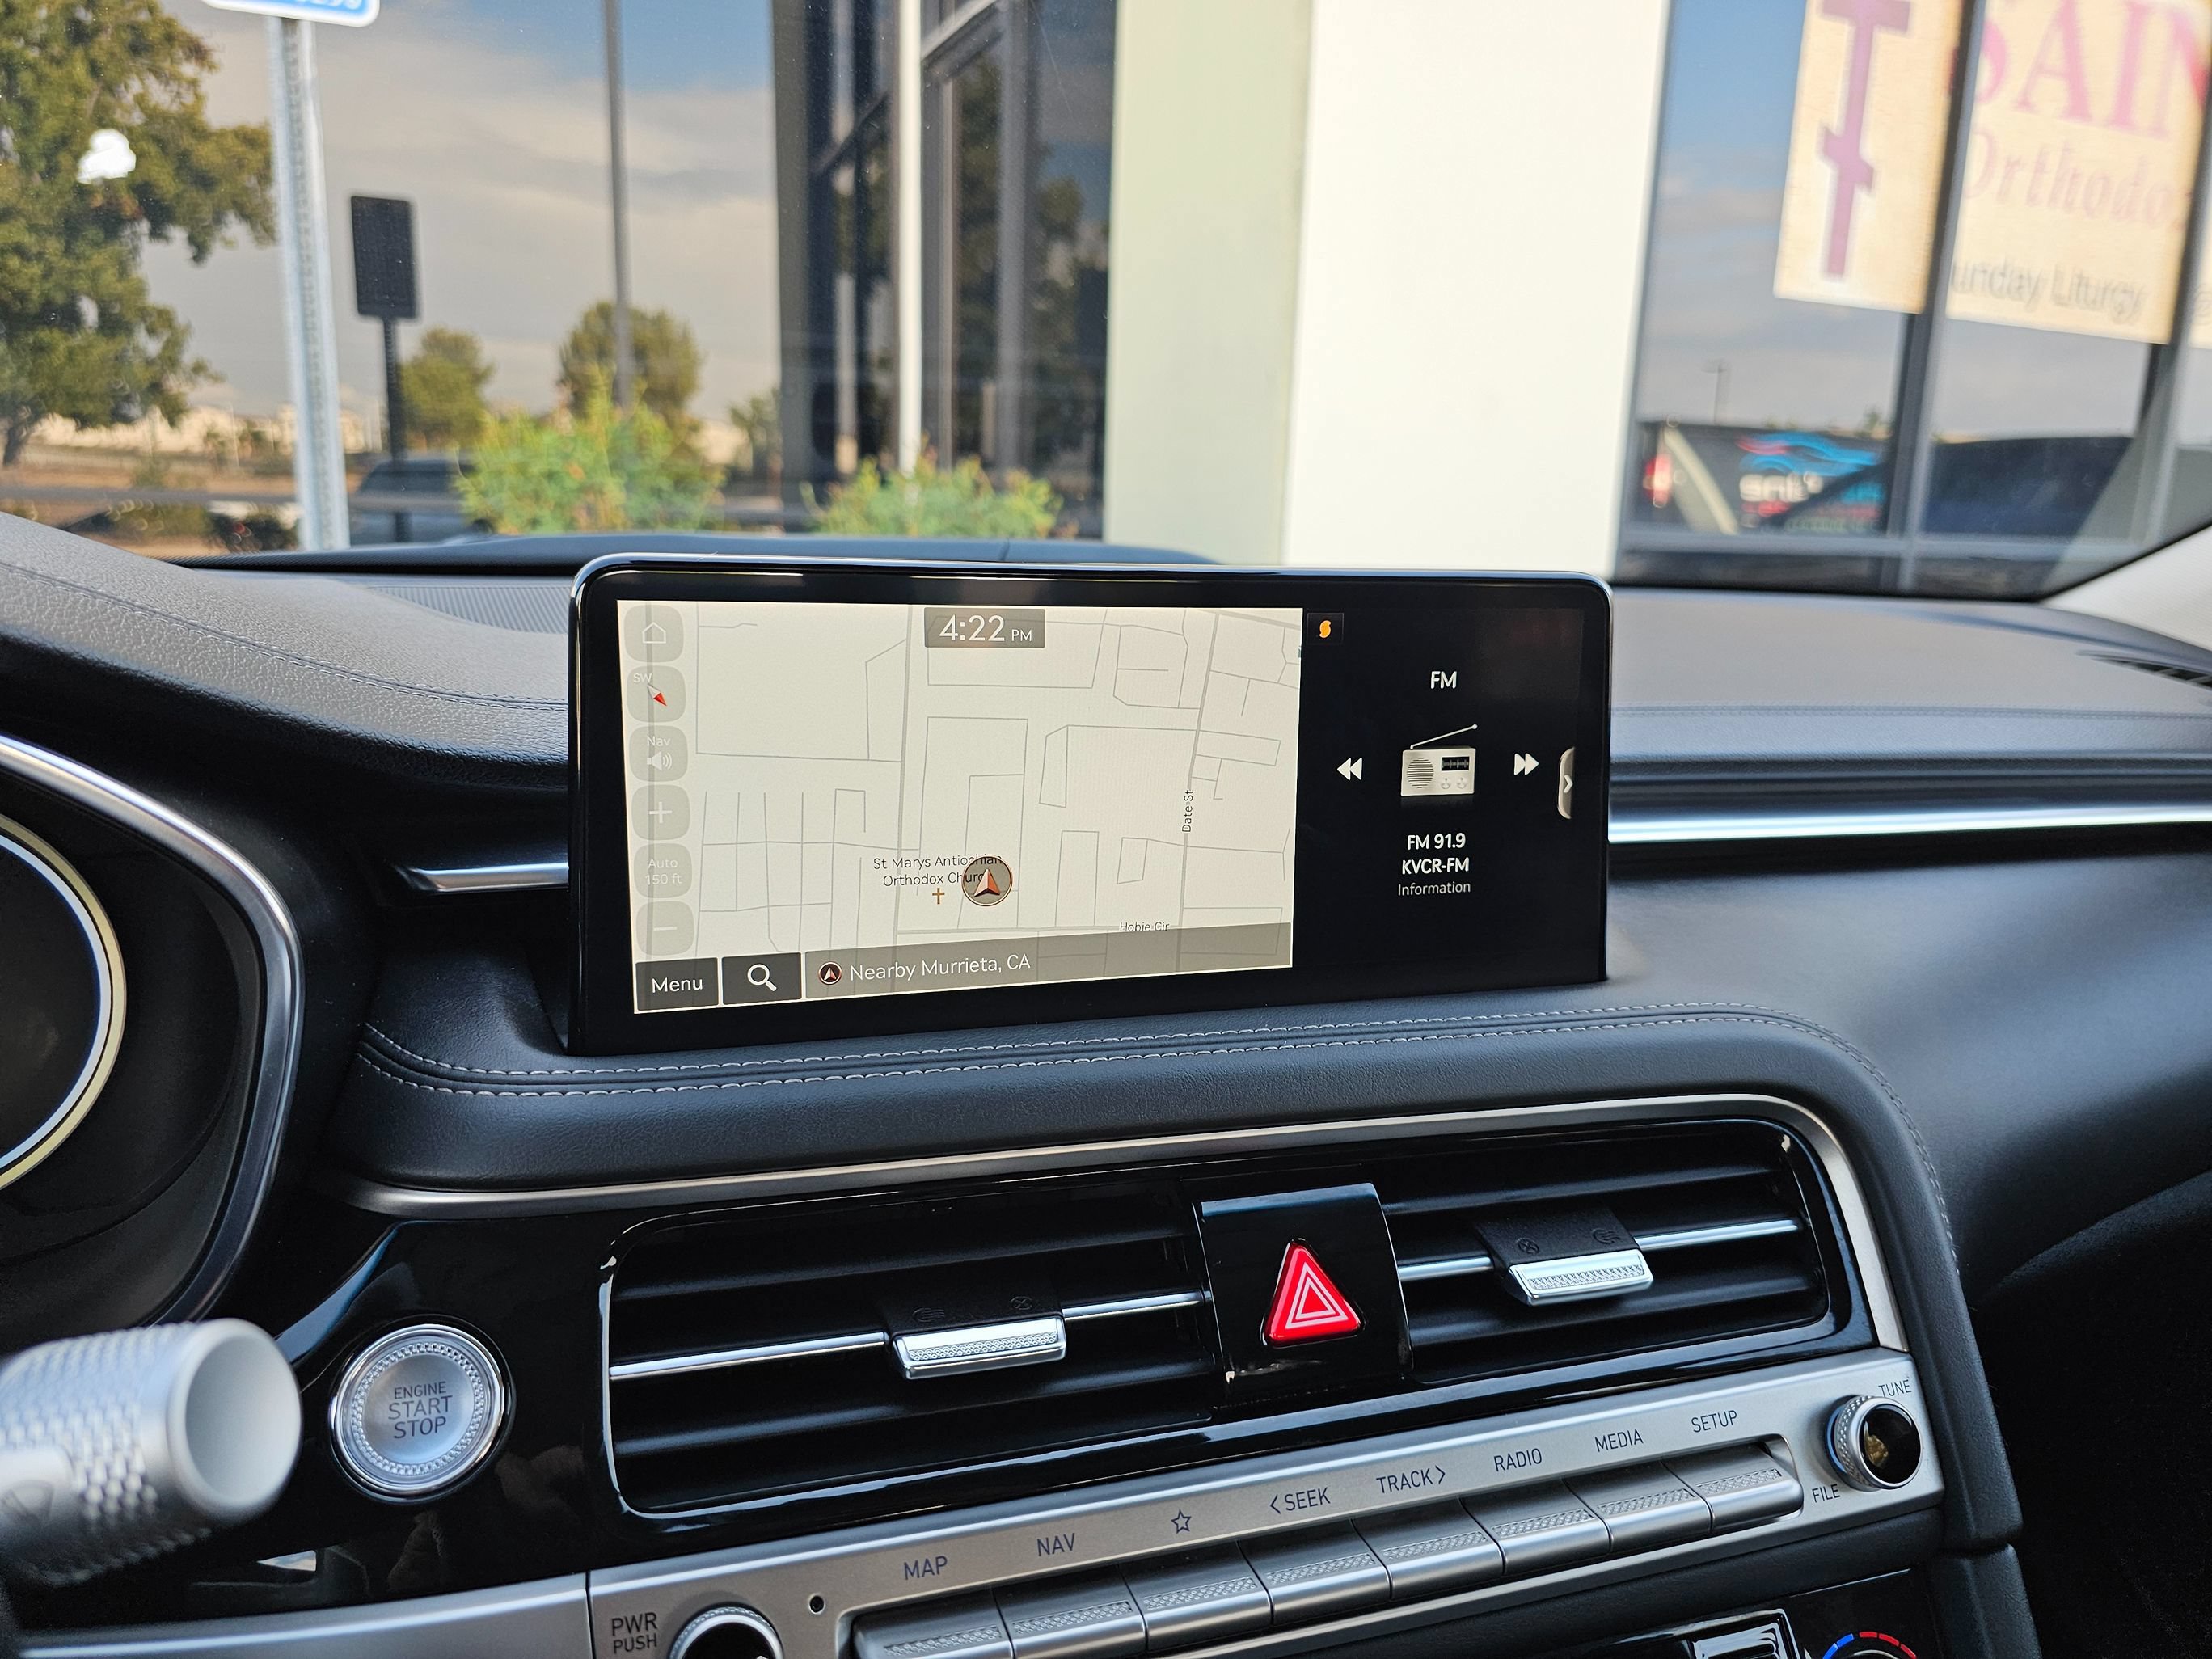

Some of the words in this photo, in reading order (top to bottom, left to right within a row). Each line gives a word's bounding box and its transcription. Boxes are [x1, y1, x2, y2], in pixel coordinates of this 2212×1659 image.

[939, 614, 1006, 642] 4:22
[1011, 628, 1034, 643] PM
[633, 673, 652, 683] SW
[1430, 671, 1457, 689] FM
[647, 735, 671, 746] Nav
[1183, 789, 1194, 802] St
[1181, 805, 1193, 833] Date
[1407, 834, 1429, 850] FM
[1434, 832, 1467, 849] 91.9
[648, 858, 678, 869] Auto
[873, 858, 887, 870] St
[891, 857, 931, 871] Marys
[1401, 857, 1470, 875] KVCR-FM
[645, 873, 669, 886] 150
[673, 873, 682, 884] ft
[883, 874, 944, 887] Orthodox
[1398, 881, 1471, 897] Information
[1120, 921, 1151, 932] Hobie
[1155, 921, 1170, 932] Cir
[850, 962, 917, 981] Nearby
[922, 959, 1003, 977] Murrieta,
[1007, 954, 1032, 970] CA
[652, 976, 703, 993] Menu
[394, 1382, 447, 1399] ENGINE
[1878, 1378, 1913, 1398] TUNE
[388, 1395, 454, 1420] START
[394, 1416, 446, 1438] STOP
[1691, 1410, 1739, 1433] SETUP
[1594, 1429, 1644, 1453] MEDIA
[1494, 1448, 1543, 1473] RADIO
[1376, 1469, 1433, 1496] TRACK
[1284, 1486, 1331, 1512] SEEK
[1812, 1483, 1841, 1505] FILE
[1036, 1531, 1077, 1557] NAV
[902, 1554, 948, 1581] MAP
[611, 1611, 659, 1636] PWR
[613, 1633, 658, 1654] PUSH
